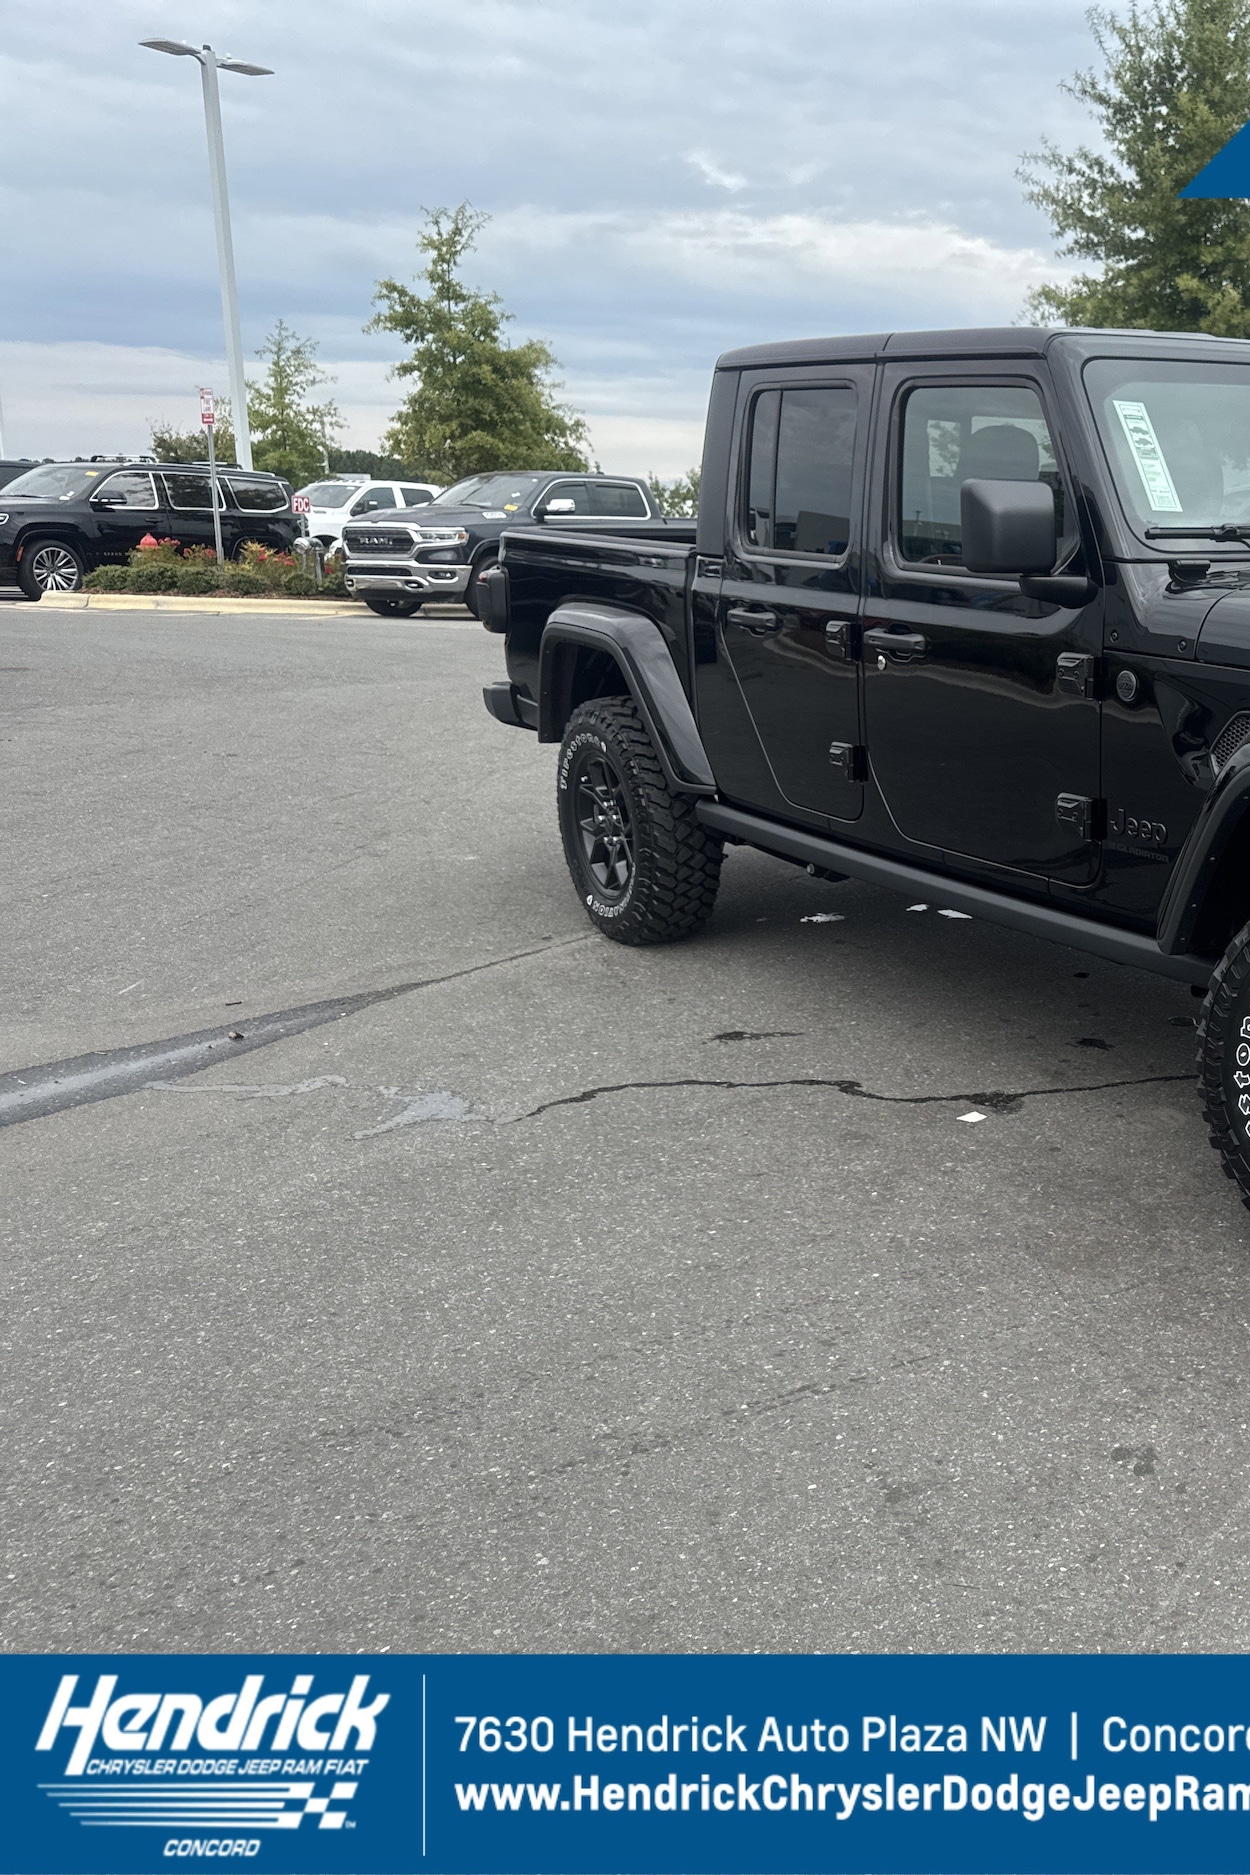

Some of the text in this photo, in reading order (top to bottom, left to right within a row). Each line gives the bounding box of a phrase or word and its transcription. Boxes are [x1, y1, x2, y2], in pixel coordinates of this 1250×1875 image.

[293, 497, 309, 512] FDC
[358, 536, 391, 545] RAM
[1109, 808, 1168, 849] Jeep
